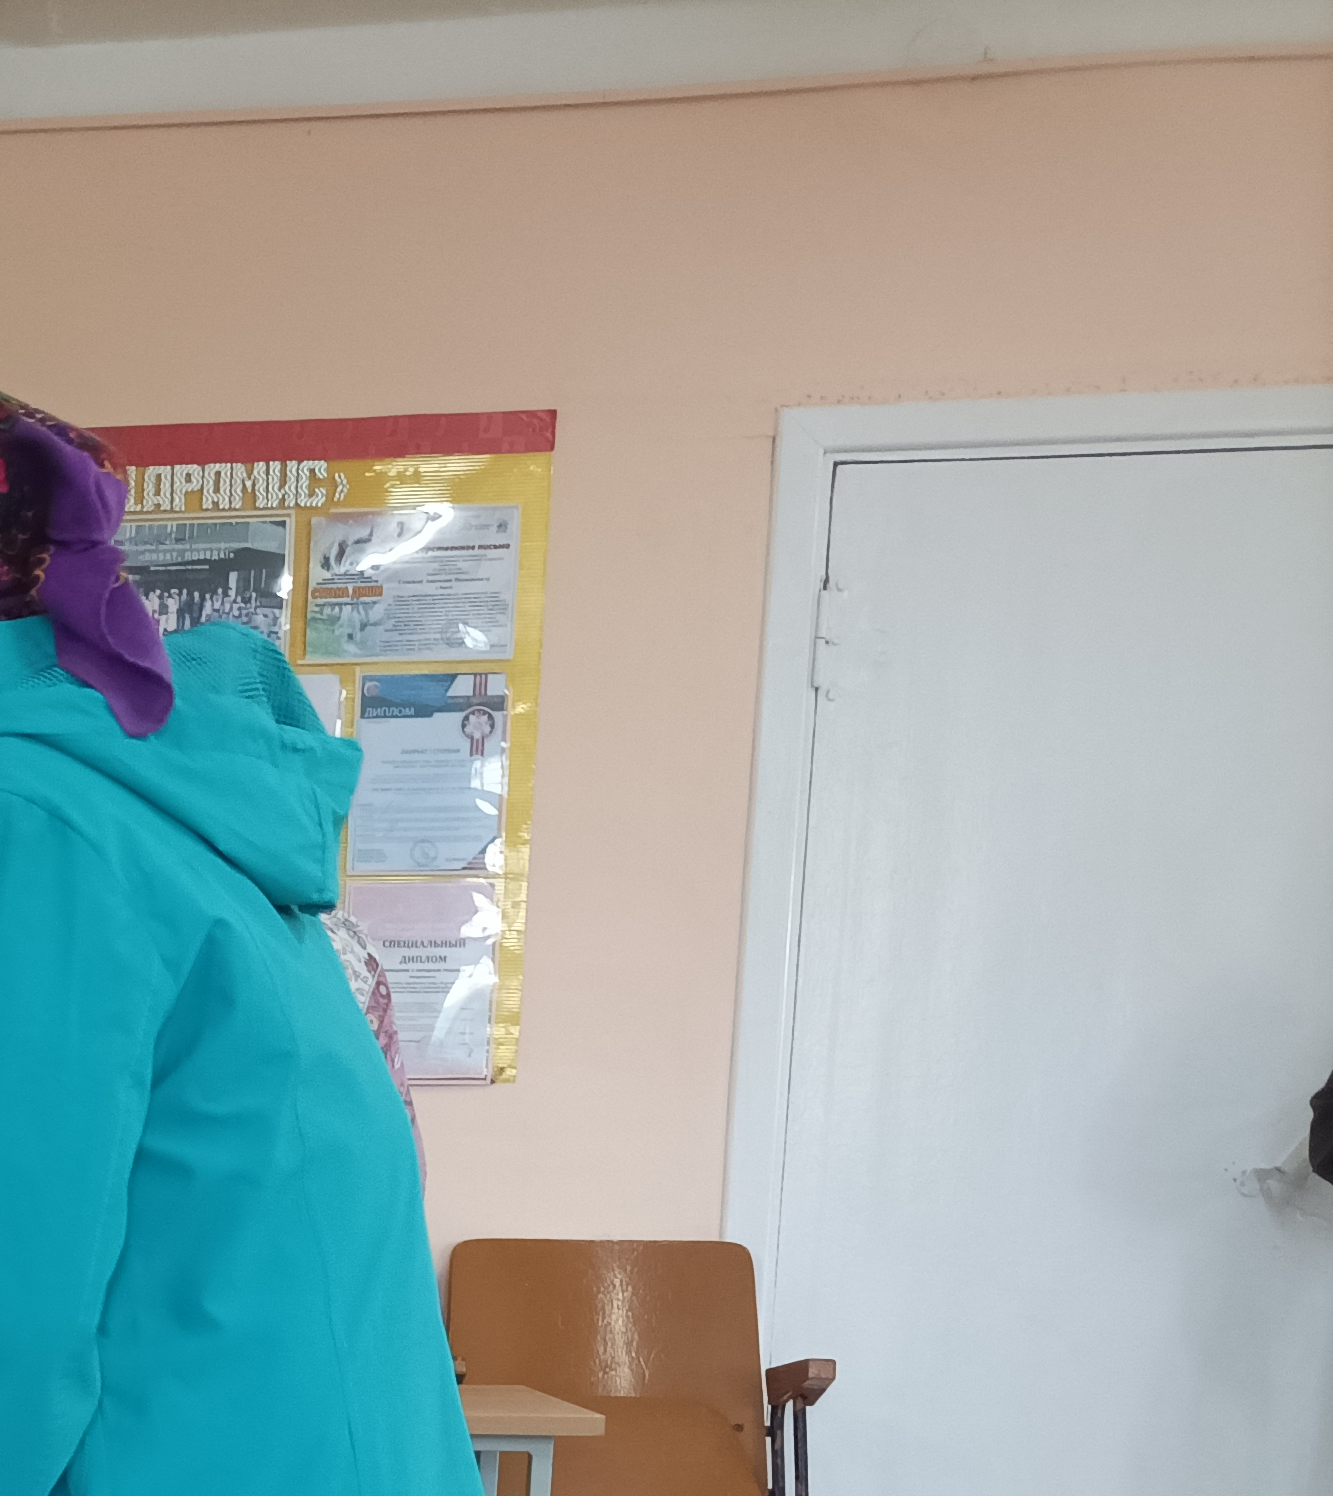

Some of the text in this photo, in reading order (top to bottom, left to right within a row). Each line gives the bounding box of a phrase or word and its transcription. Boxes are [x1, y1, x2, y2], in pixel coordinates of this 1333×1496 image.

[364, 706, 414, 717] ДИПЛОМ
[383, 938, 466, 950] СПЕЦИАЛЬНЫЙ
[399, 955, 447, 965] ДИПЛОМ
